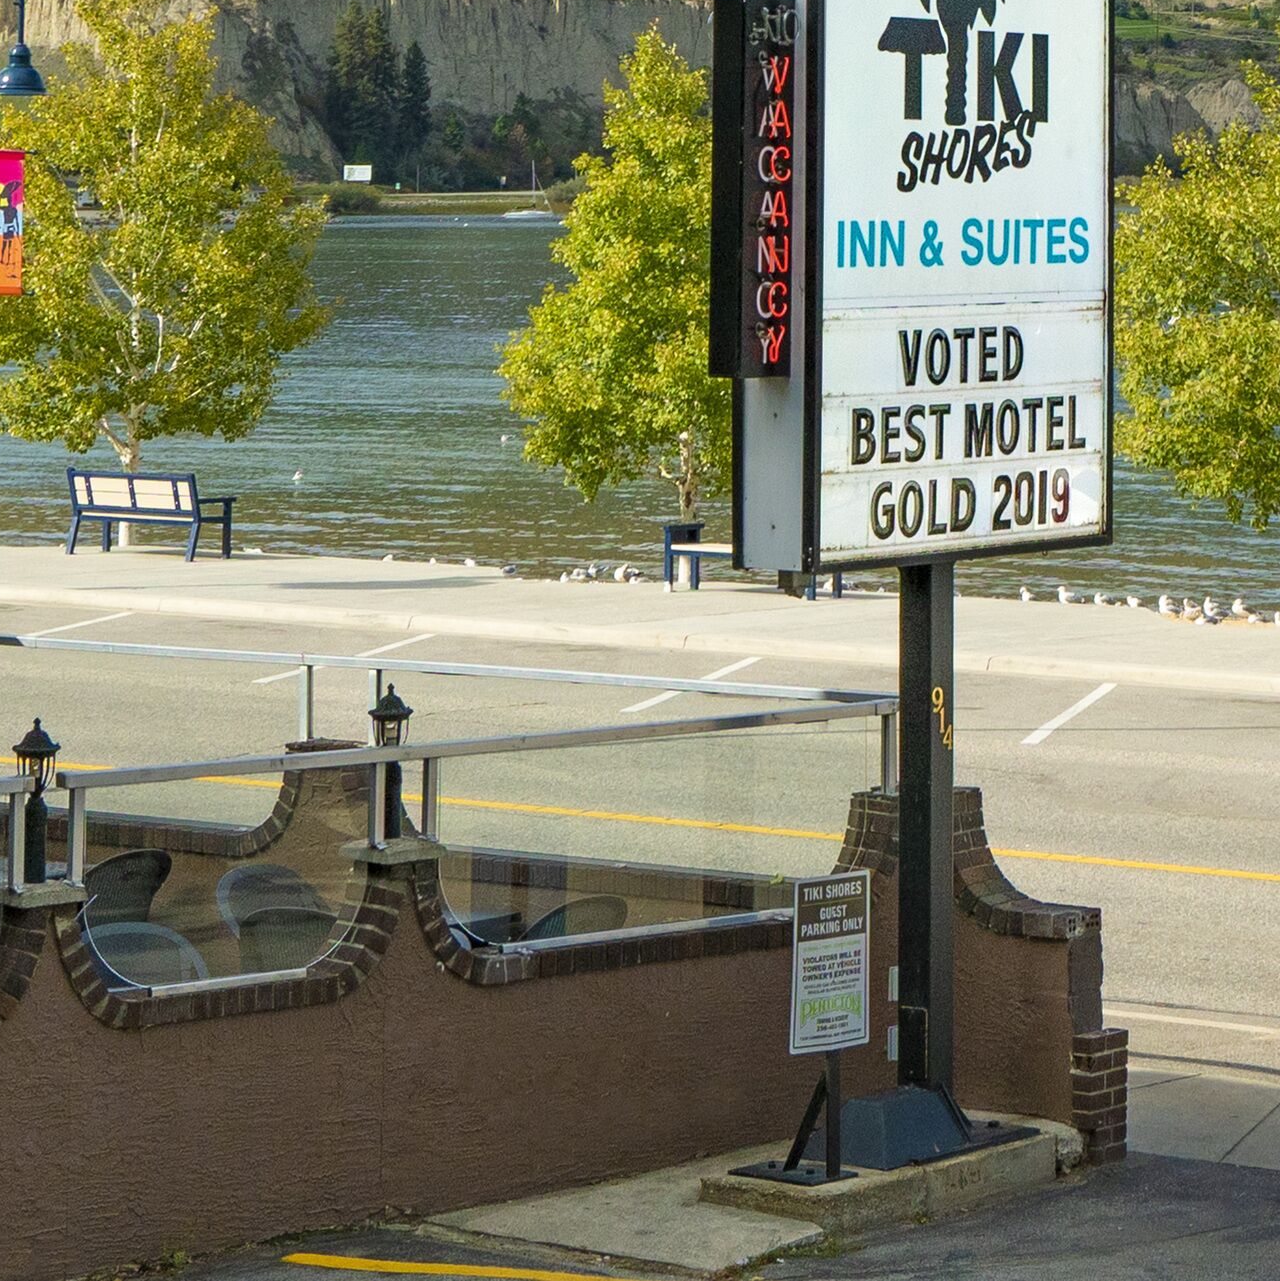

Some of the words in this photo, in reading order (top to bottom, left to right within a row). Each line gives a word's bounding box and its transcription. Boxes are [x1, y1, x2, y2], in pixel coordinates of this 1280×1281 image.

[877, 16, 1049, 126] TIKI
[896, 109, 1037, 193] SHORES
[766, 54, 792, 363] VACANCY
[837, 220, 905, 268] INN
[919, 220, 944, 267] &
[961, 216, 1090, 267] SUITES
[898, 325, 1024, 387] VOTED
[851, 403, 951, 465] BEST
[964, 395, 1086, 459] MOTEL
[870, 477, 977, 540] GOLD
[992, 467, 1070, 531] 2019
[931, 686, 953, 751] 914
[803, 886, 823, 901] TIKI
[825, 880, 862, 898] SHORES
[819, 904, 847, 920] GUEST
[801, 920, 840, 937] PARKING
[842, 916, 863, 931] ONLY
